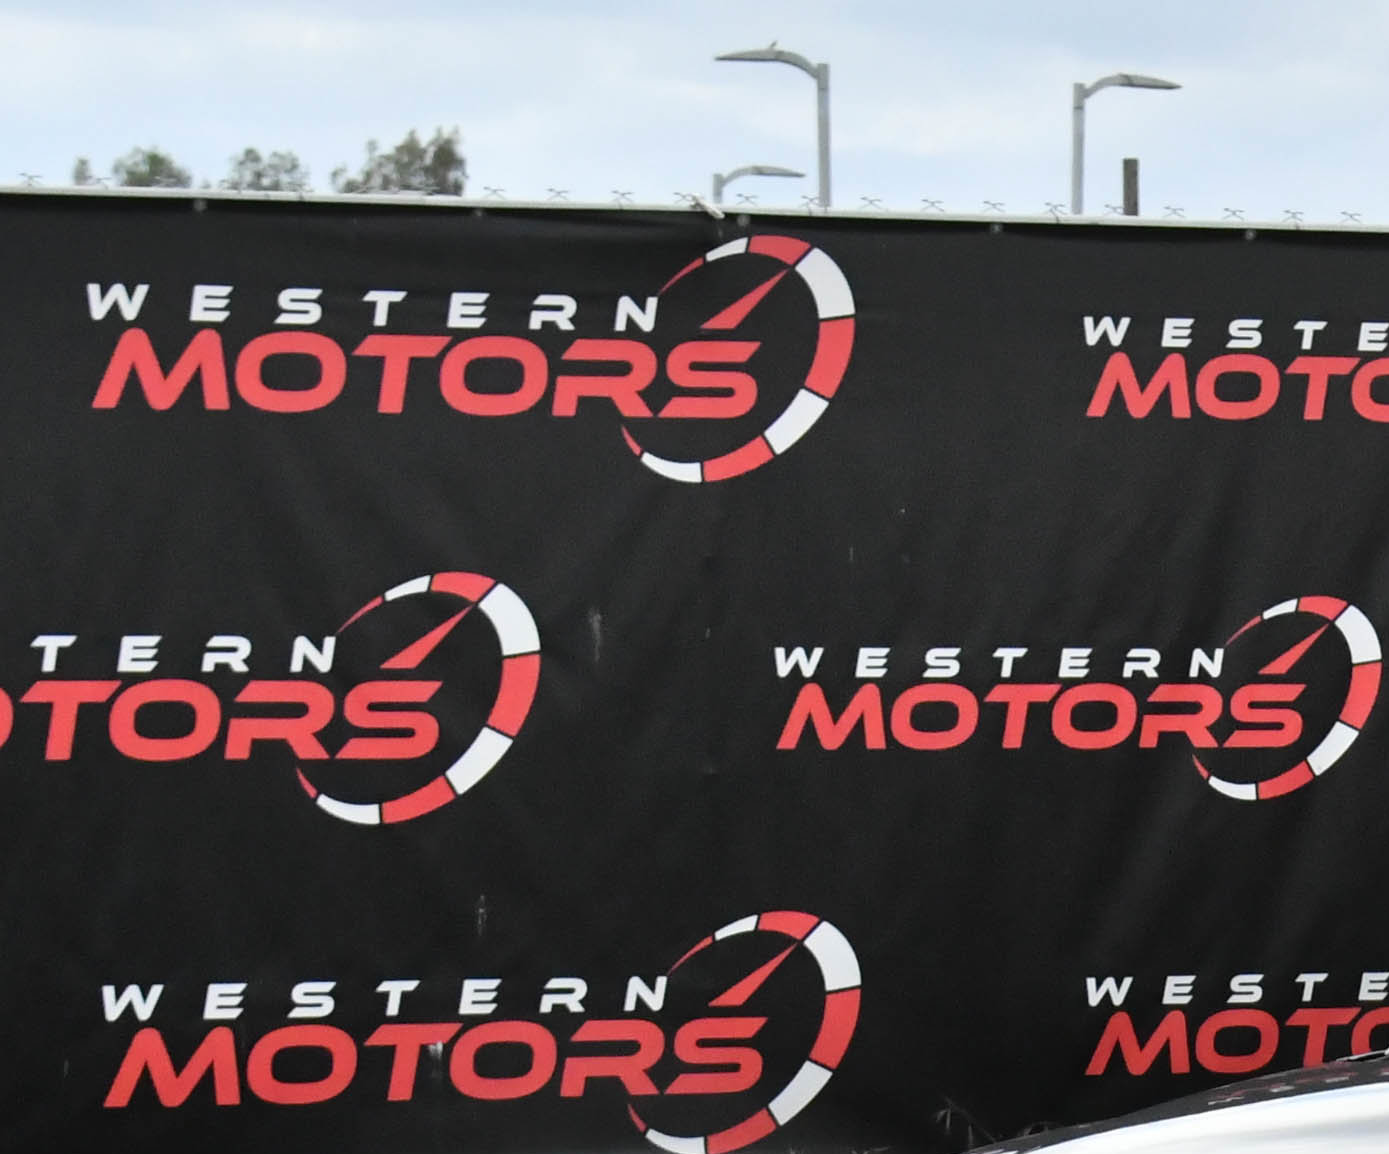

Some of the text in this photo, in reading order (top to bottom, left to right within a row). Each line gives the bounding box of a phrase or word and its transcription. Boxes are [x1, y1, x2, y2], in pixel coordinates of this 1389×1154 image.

[87, 283, 658, 332] WESTERN
[92, 328, 760, 418] MOTORS
[31, 636, 336, 673] TERN
[775, 647, 1224, 678] WESTERN
[0, 679, 442, 761] TORS
[778, 683, 1306, 750] MOTORS
[102, 976, 667, 1021] WESTERN
[104, 1017, 767, 1107] MOTORS
